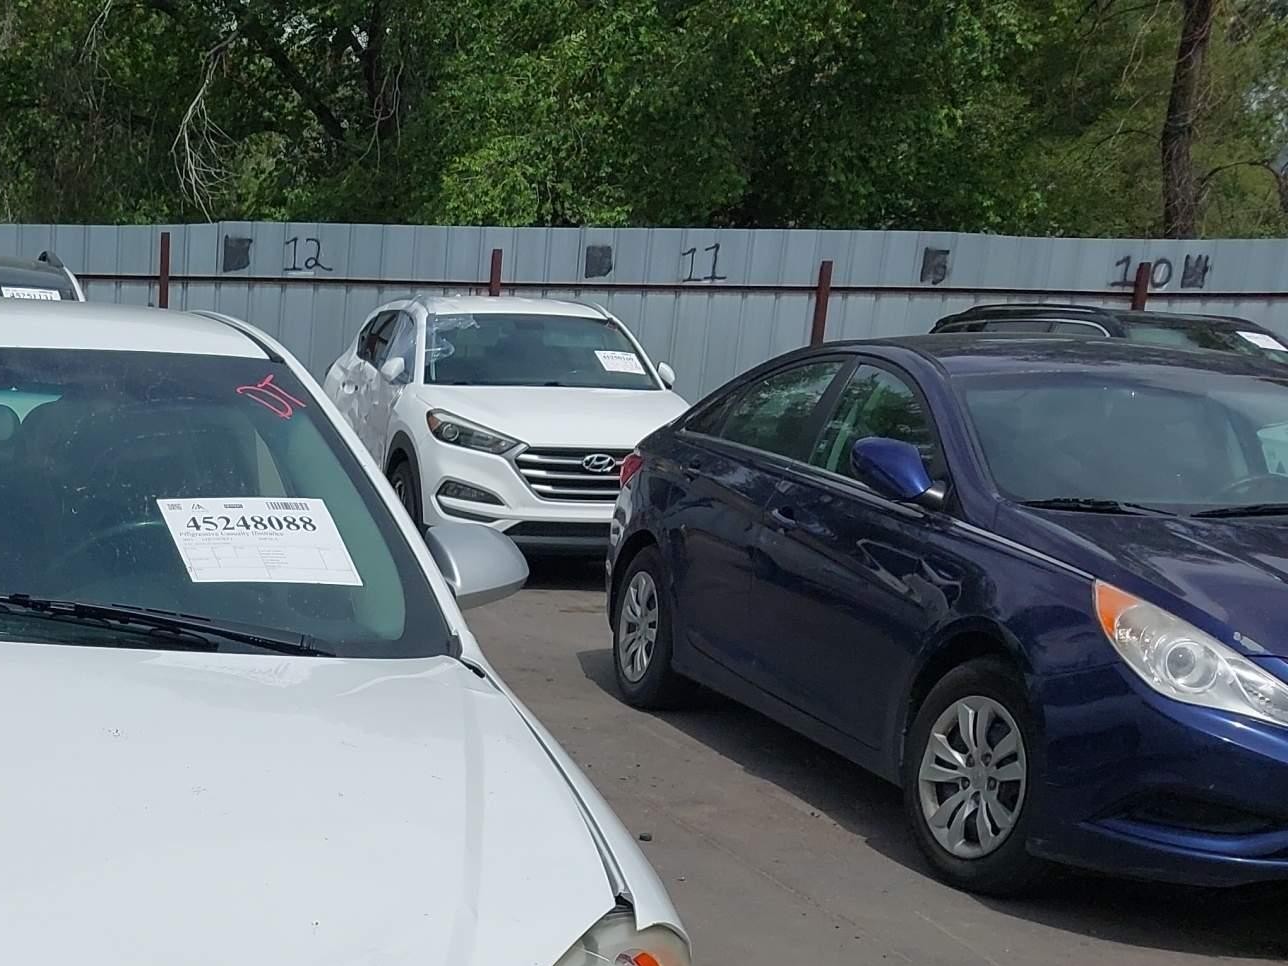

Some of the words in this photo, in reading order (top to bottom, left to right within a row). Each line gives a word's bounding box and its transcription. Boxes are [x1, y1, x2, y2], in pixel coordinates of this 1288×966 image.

[283, 236, 333, 271] 12
[681, 242, 727, 282] 11
[186, 514, 317, 531] 45248088
